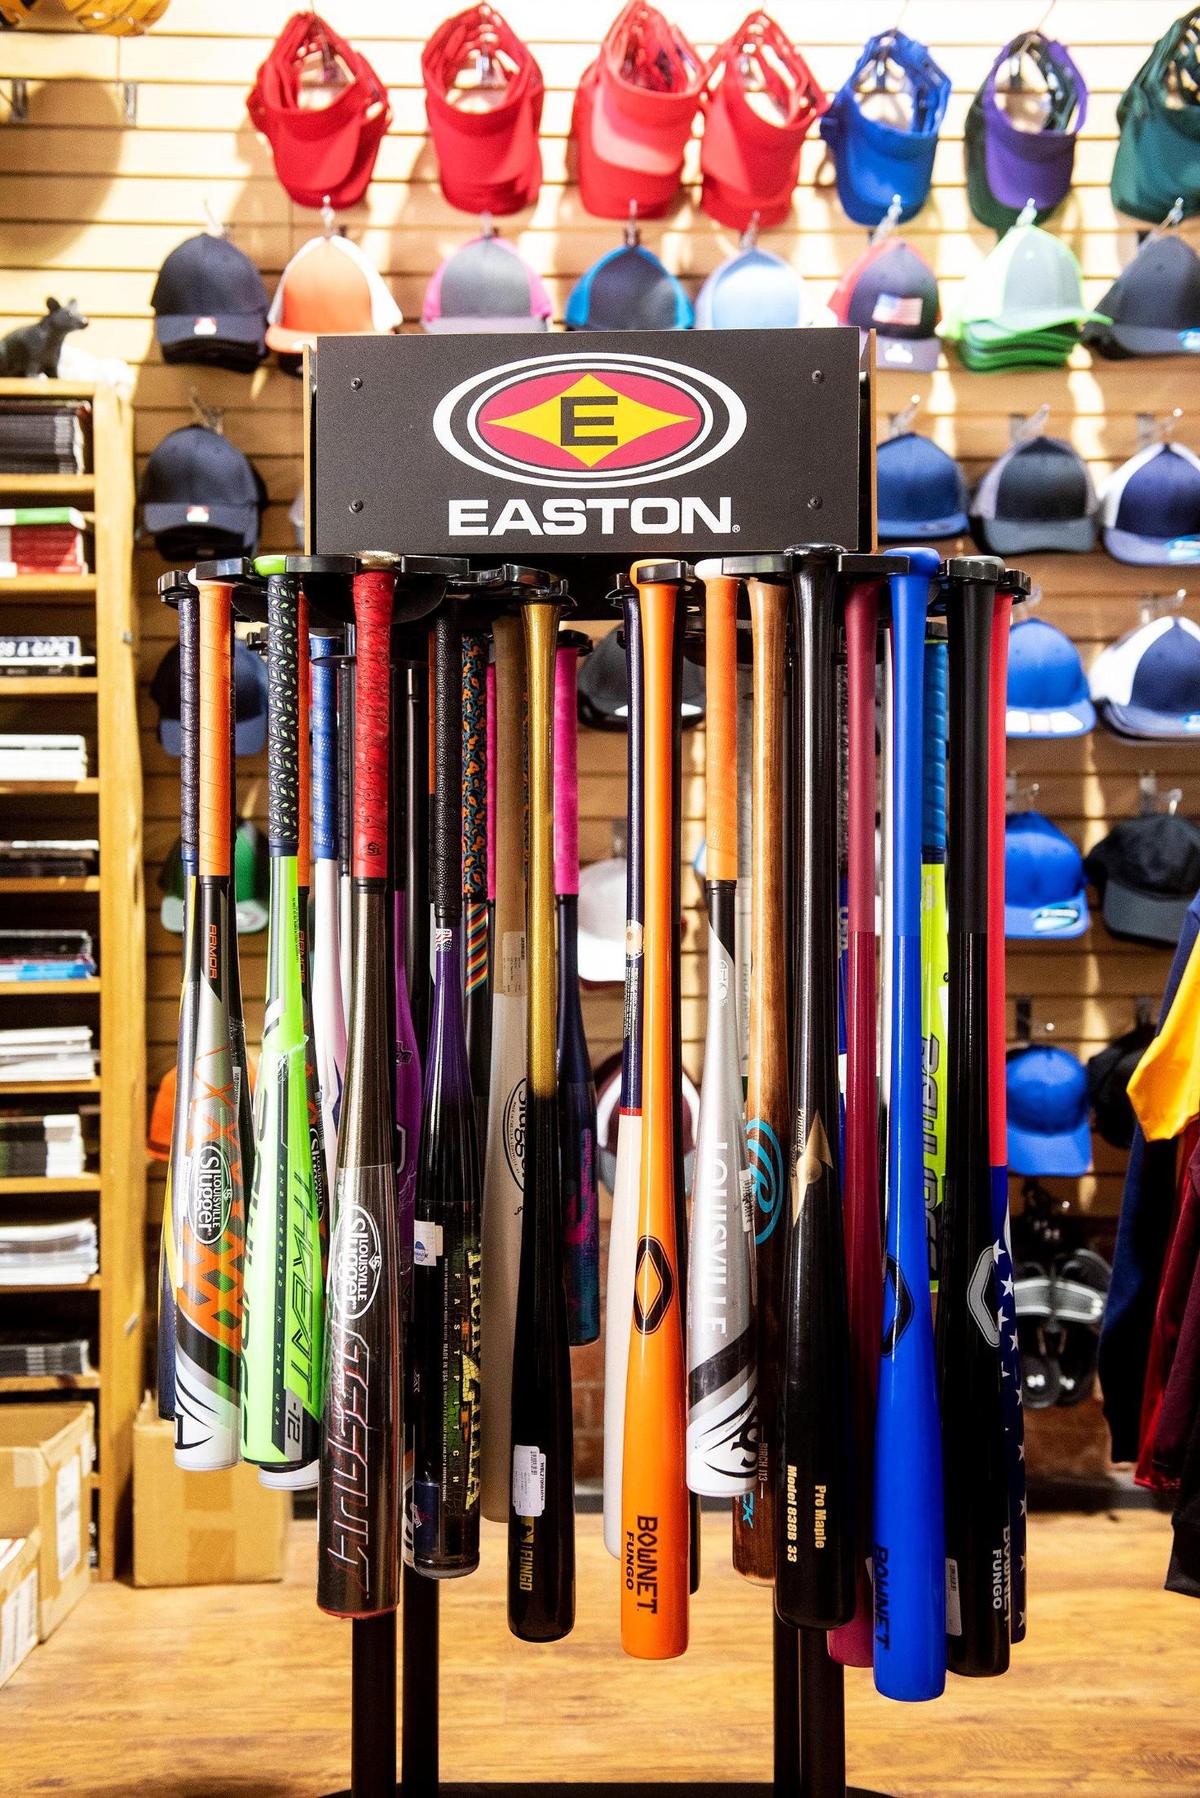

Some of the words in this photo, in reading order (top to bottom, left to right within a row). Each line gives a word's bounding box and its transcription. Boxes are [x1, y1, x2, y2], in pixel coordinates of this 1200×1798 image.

[560, 396, 618, 446] E
[448, 497, 732, 536] EASTON
[208, 924, 218, 980] ARMOR
[797, 1108, 807, 1154] Pinnacle
[196, 1156, 222, 1233] Slugger
[212, 1174, 222, 1228] LOUISVILLE
[338, 1217, 369, 1307] Slugger
[702, 1142, 728, 1334] LOUISVILLE
[357, 1239, 369, 1301] LOUISVILLE
[277, 1305, 282, 1323] IN
[758, 1442, 768, 1467] BIRCH
[787, 1464, 797, 1506] Model
[815, 1484, 827, 1507] Pro
[787, 1506, 797, 1541] 838B
[814, 1509, 827, 1549] Maple
[519, 1549, 533, 1591] FUNGO
[626, 1531, 635, 1590] FUNGO
[637, 1515, 658, 1615] BOWNET
[787, 1544, 797, 1563] 33
[873, 1543, 890, 1650] BOWNET
[992, 1549, 1002, 1609] FUNGO
